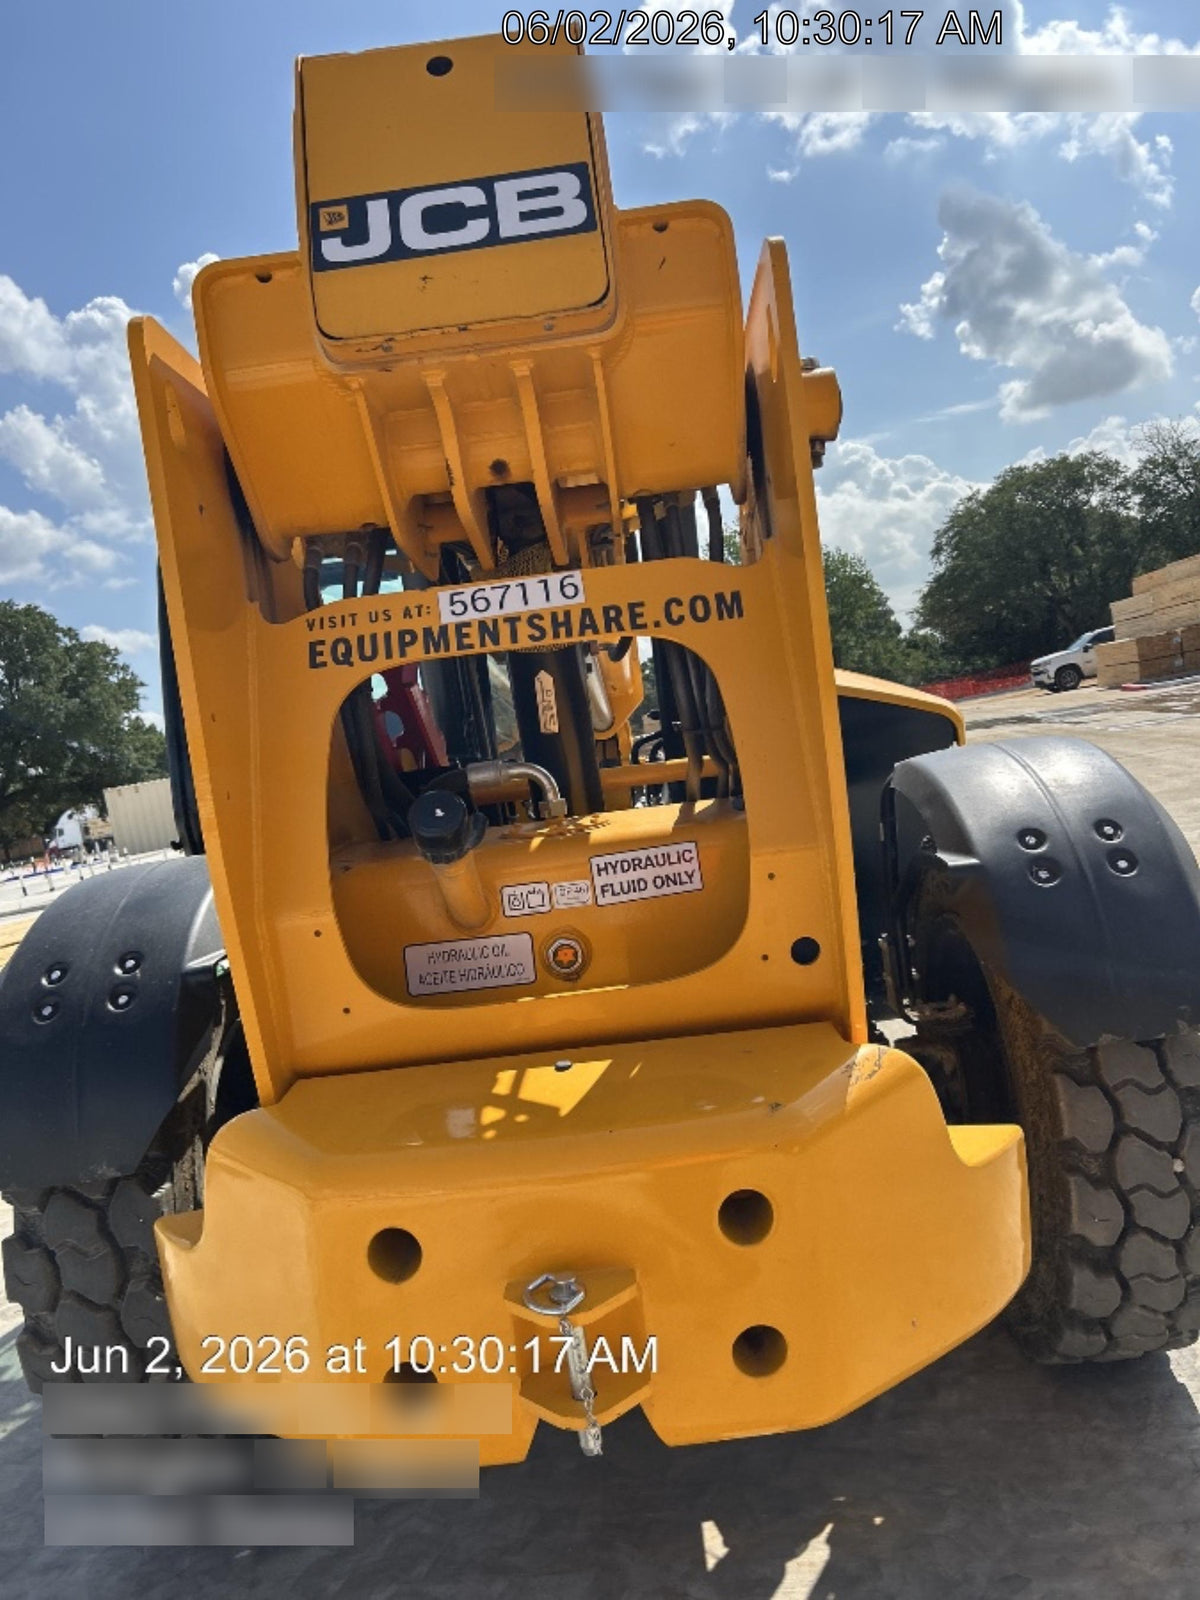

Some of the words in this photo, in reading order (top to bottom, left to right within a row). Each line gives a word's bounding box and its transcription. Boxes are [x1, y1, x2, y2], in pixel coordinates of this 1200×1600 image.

[321, 171, 587, 262] JCB
[449, 573, 580, 617] 567116
[306, 613, 358, 632] VISIT
[369, 609, 392, 624] US
[403, 604, 432, 621] AT:
[308, 590, 744, 669] EQUIPMENTSHARE.COM
[596, 849, 694, 877] HYDRAULIC
[600, 878, 648, 898] FLUID
[653, 869, 696, 890] ONLY
[427, 945, 490, 965] HYDRAULIC
